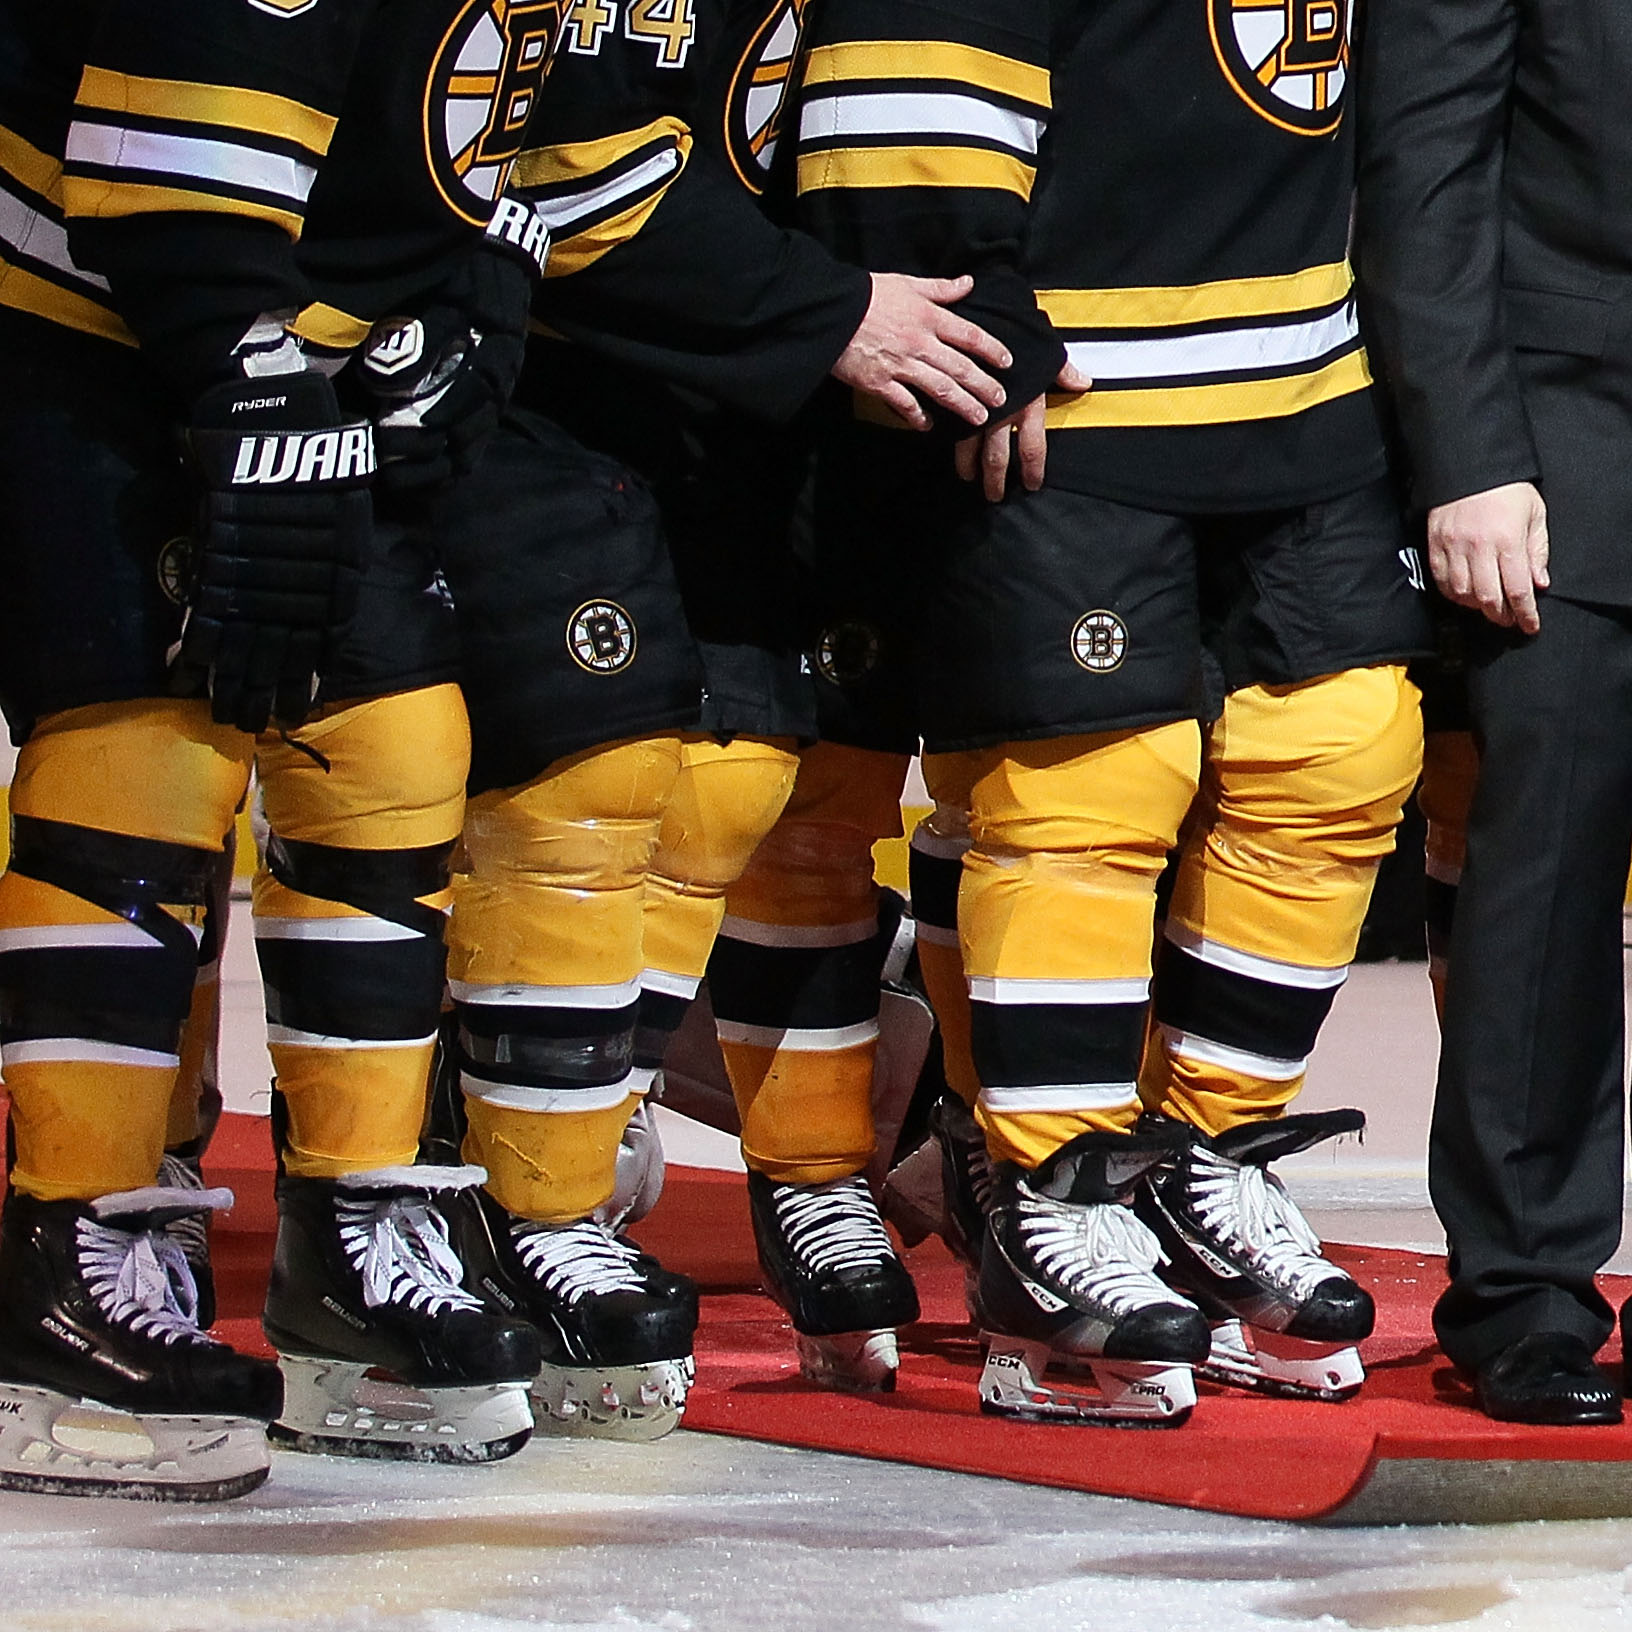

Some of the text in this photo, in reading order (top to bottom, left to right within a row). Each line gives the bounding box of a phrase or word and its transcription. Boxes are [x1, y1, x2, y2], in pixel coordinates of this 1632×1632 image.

[486, 196, 551, 274] RR
[232, 395, 288, 414] RYDER
[1199, 1248, 1232, 1276] CCM
[1029, 1284, 1058, 1310] CCM
[988, 1355, 1021, 1371] CCM
